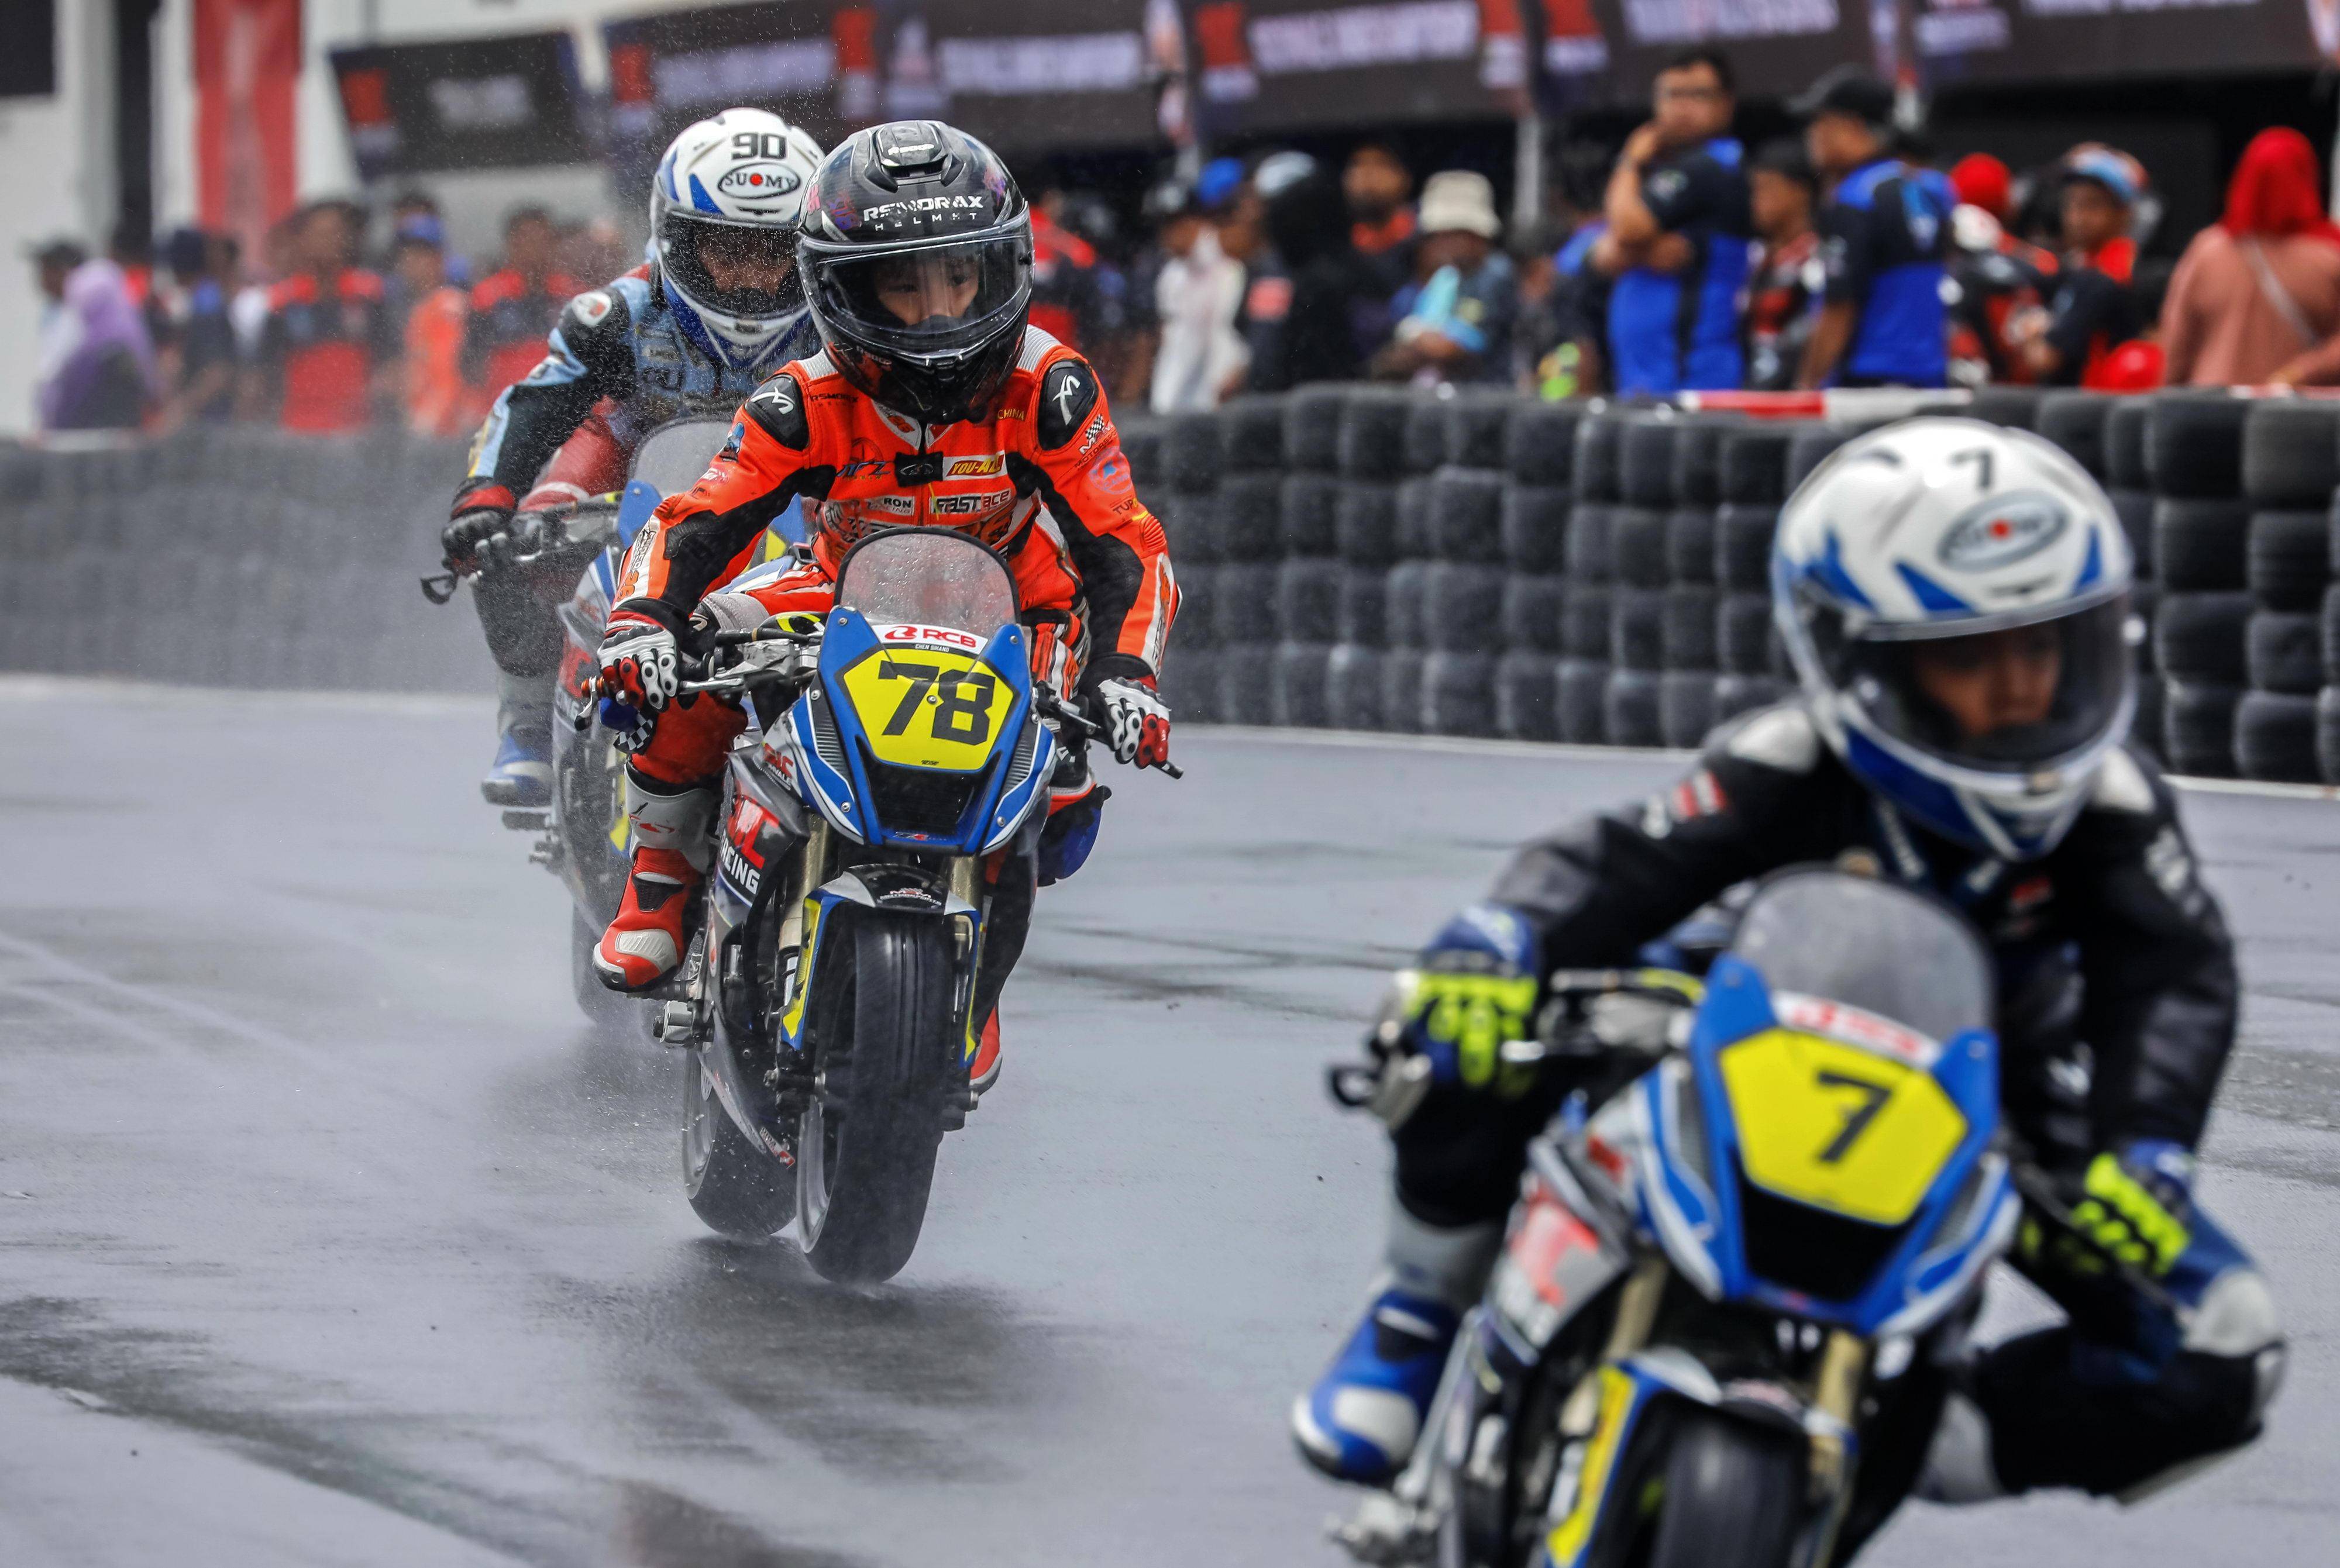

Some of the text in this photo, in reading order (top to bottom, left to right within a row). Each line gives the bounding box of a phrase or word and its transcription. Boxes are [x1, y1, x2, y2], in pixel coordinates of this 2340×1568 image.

[731, 132, 786, 160] 90
[997, 408, 1024, 422] CHINA
[1949, 446, 1994, 490] 7
[923, 628, 976, 648] RCB
[878, 660, 996, 746] 78
[1817, 1070, 1892, 1163] 7
